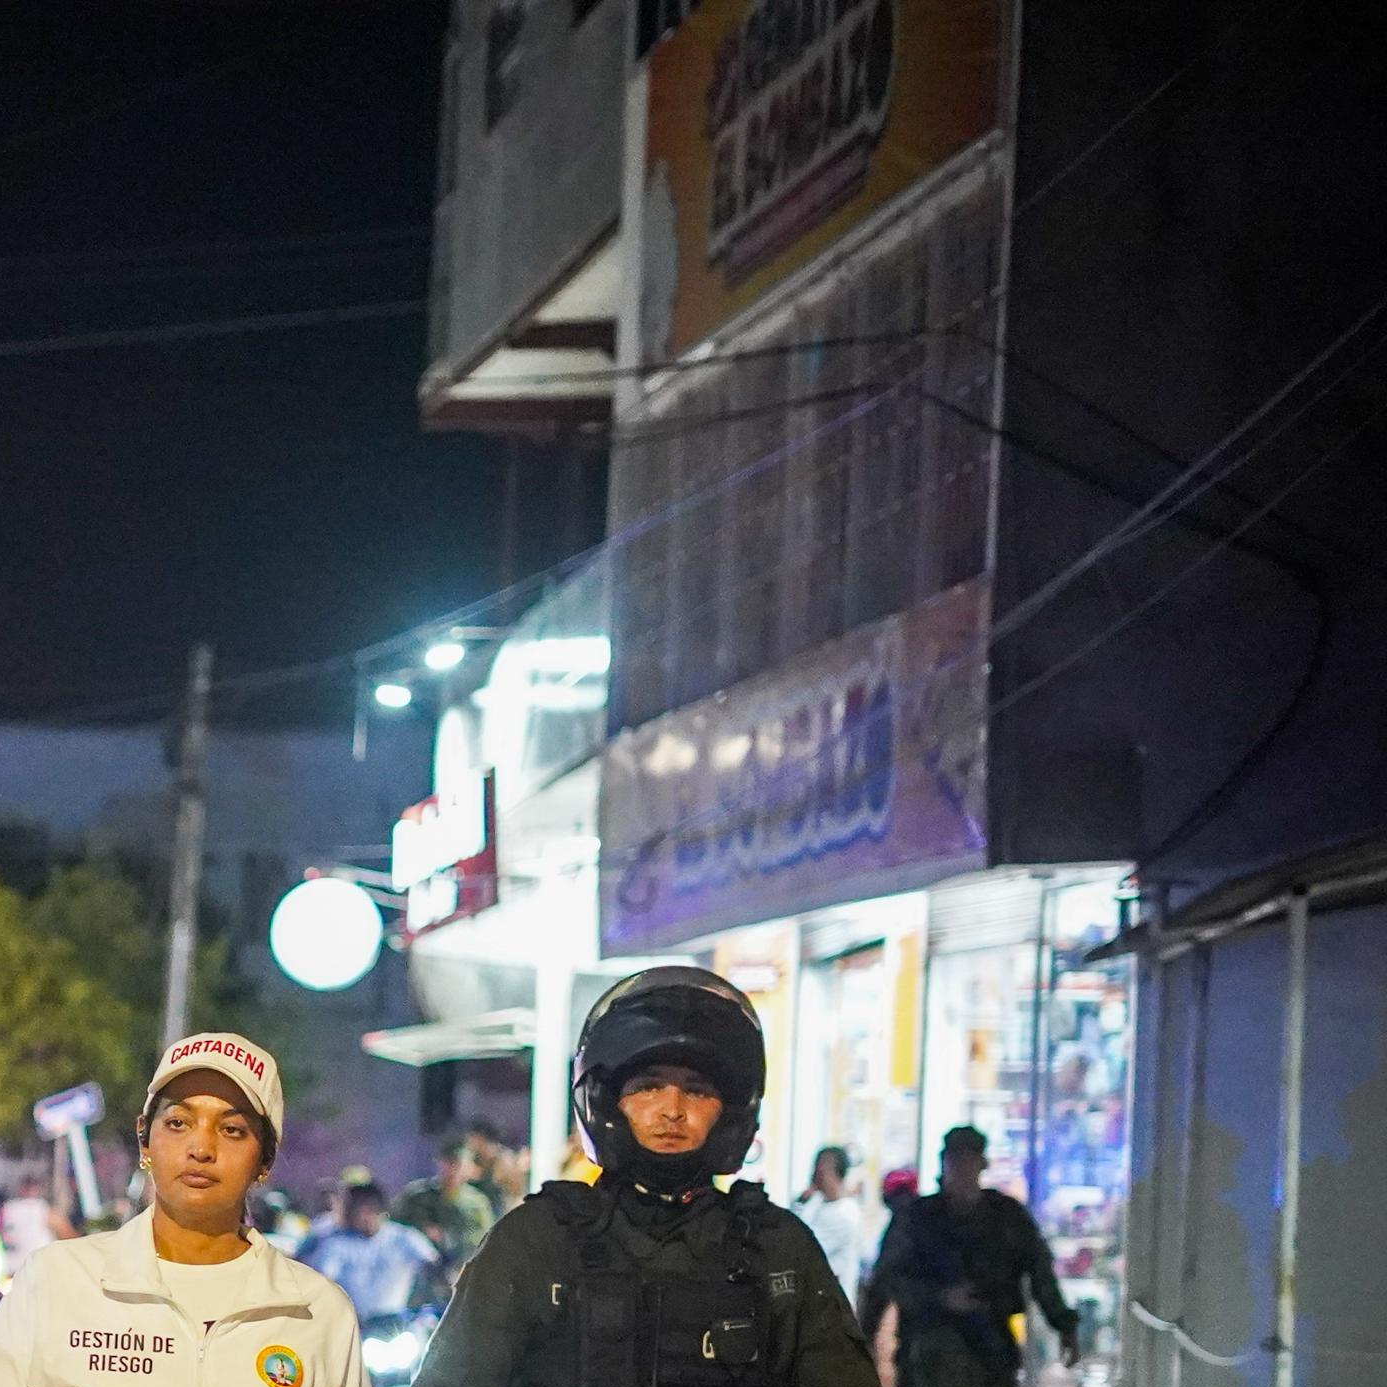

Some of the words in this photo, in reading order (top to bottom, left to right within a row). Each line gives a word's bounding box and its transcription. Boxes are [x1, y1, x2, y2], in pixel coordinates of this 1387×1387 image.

[170, 1040, 265, 1081] CARTAGENA
[69, 1328, 145, 1352] GESTIÓN
[152, 1335, 176, 1355] DE
[88, 1353, 154, 1375] RIESGO
